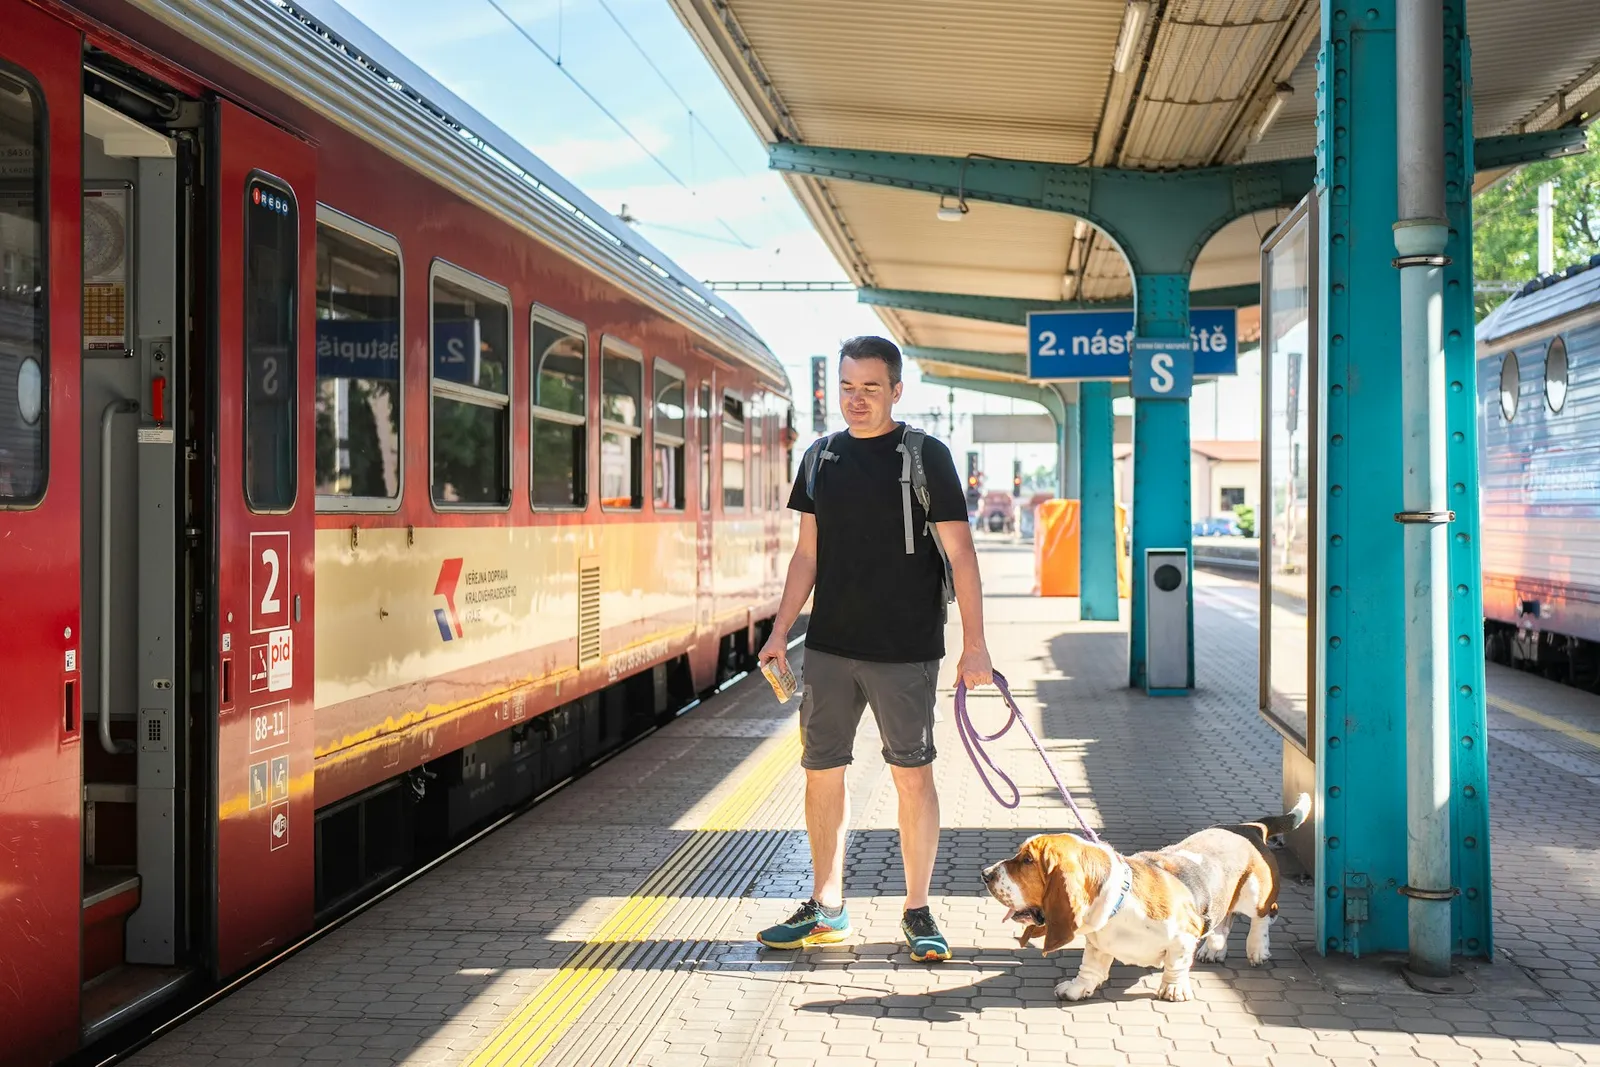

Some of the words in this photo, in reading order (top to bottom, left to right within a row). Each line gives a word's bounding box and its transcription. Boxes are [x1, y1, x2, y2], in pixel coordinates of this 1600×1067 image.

[254, 190, 288, 213] IREDO
[1038, 331, 1065, 356] 2.
[1072, 325, 1227, 356] nástště
[1150, 353, 1174, 393] S
[261, 548, 280, 614] 2
[488, 569, 508, 583] DOPRAVA
[271, 636, 290, 669] pid
